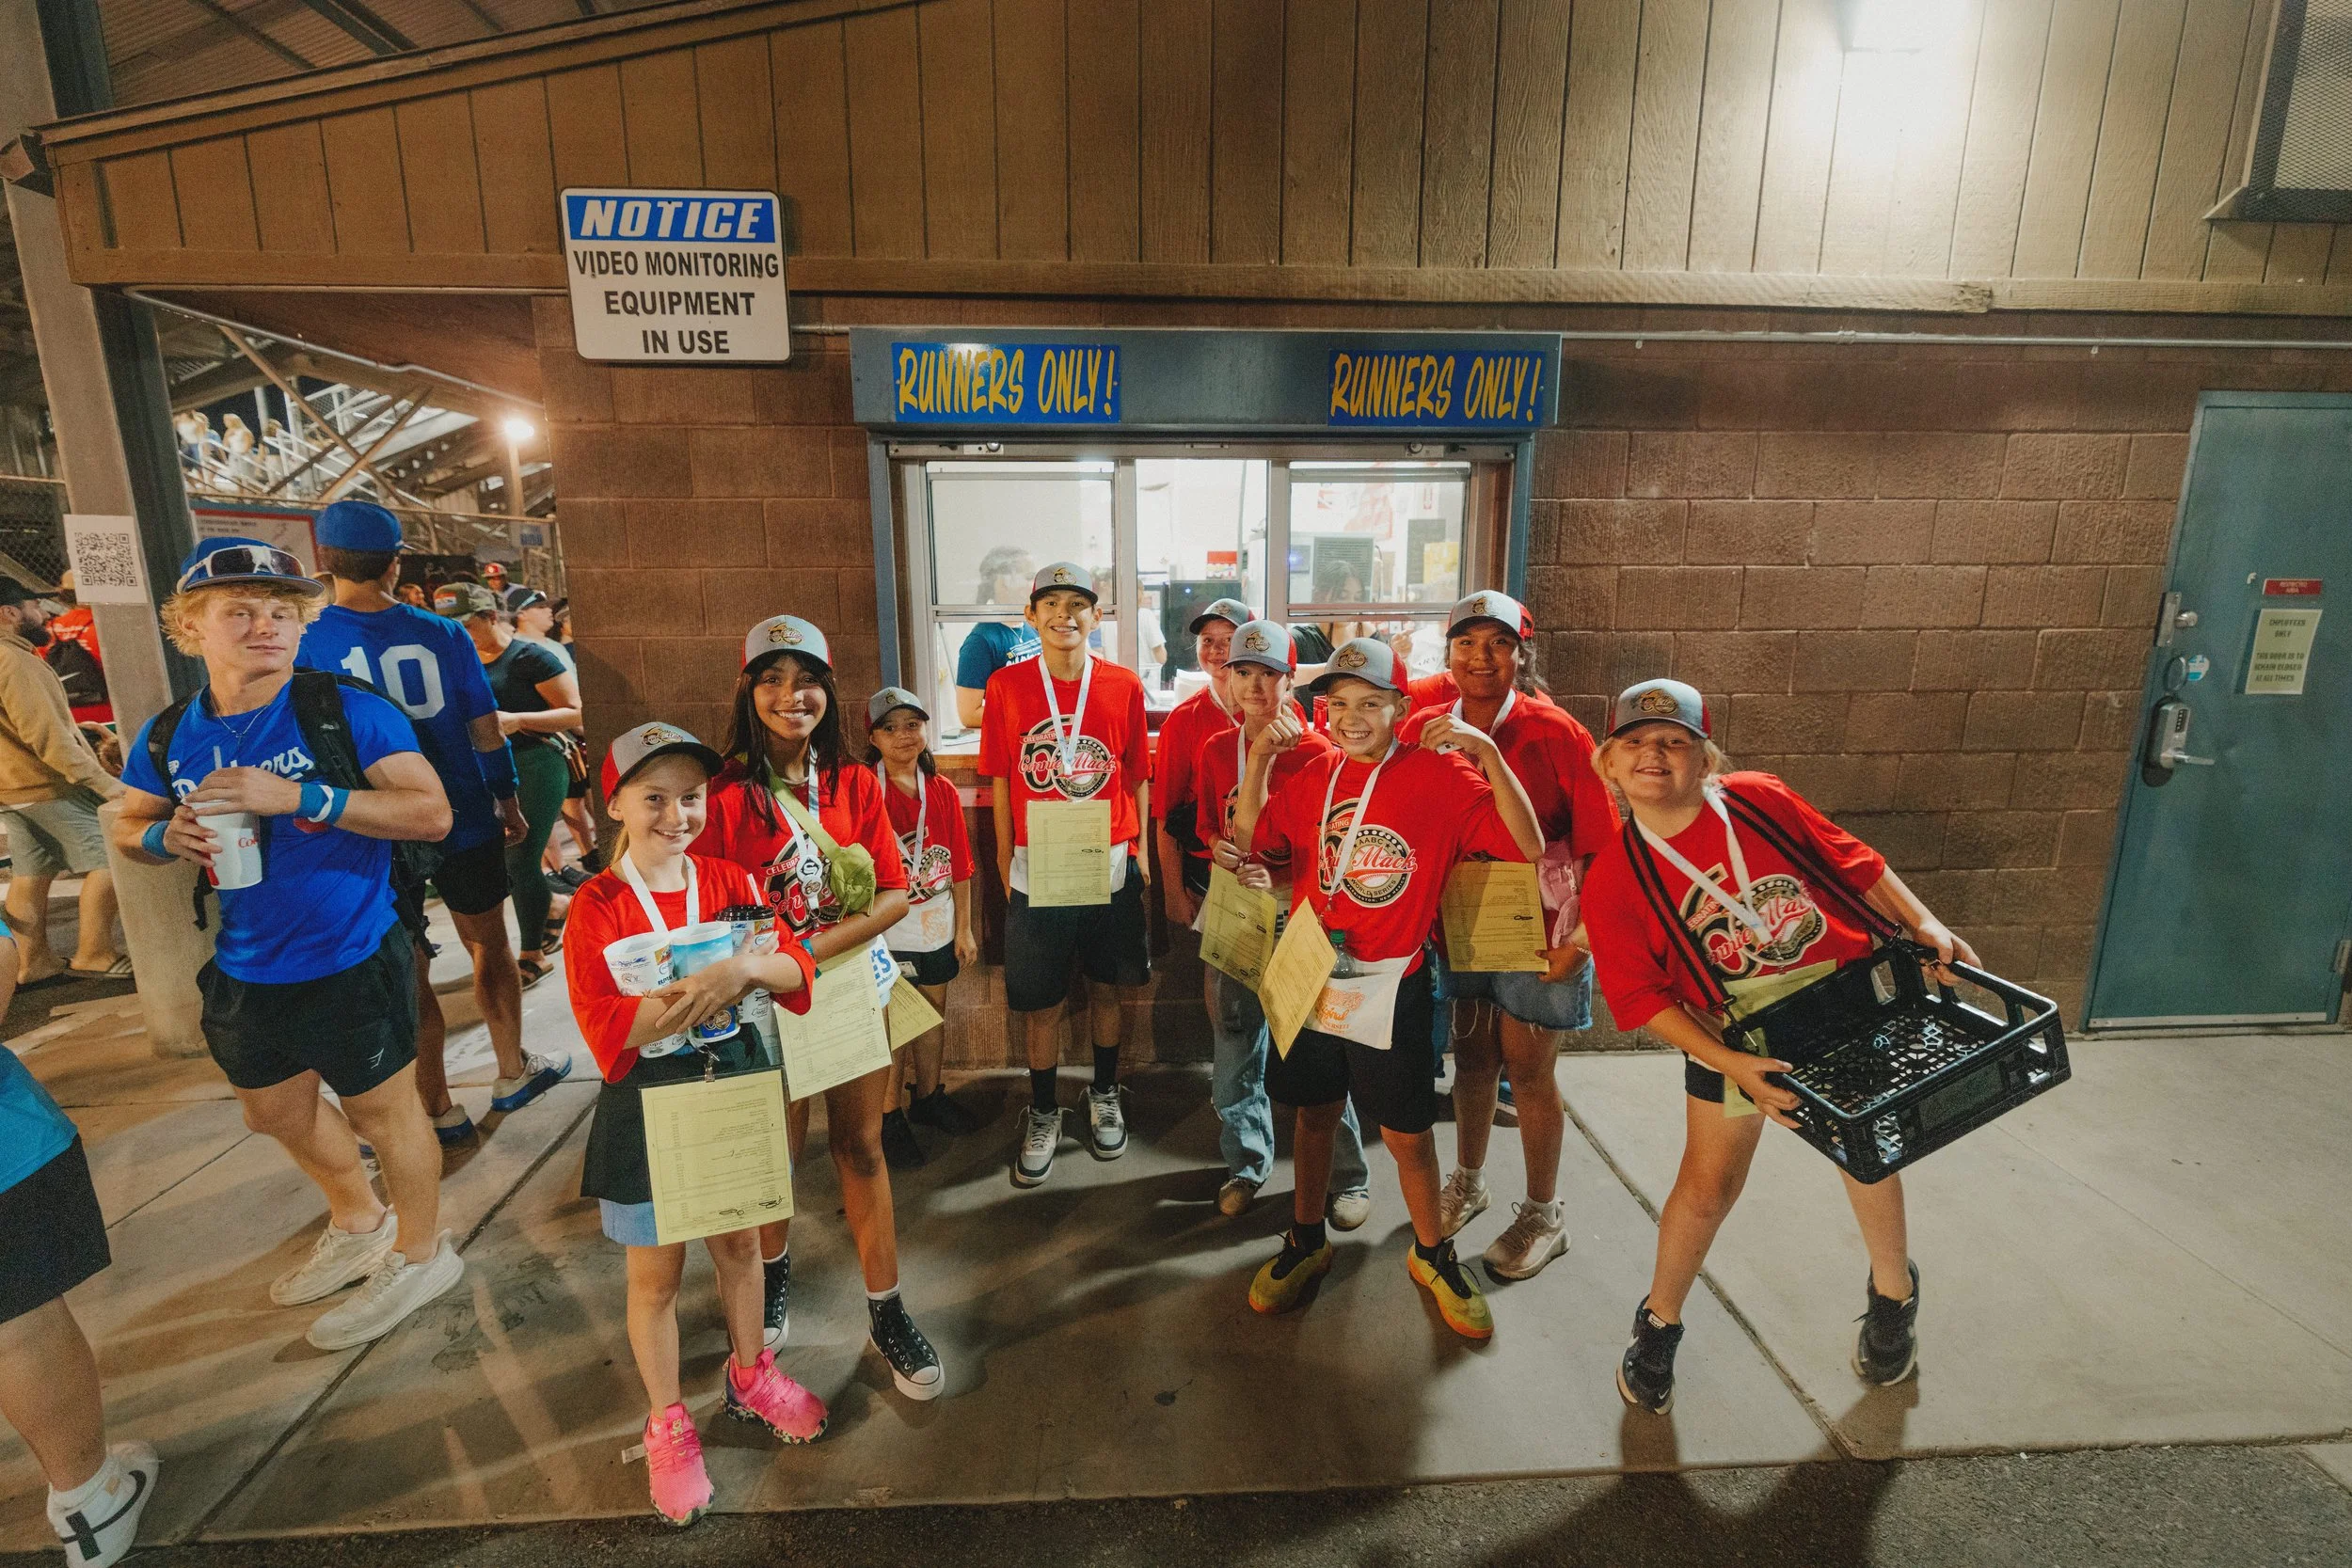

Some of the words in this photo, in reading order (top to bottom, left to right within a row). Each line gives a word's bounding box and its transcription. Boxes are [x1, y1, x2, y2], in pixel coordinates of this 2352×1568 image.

[580, 199, 762, 239] NOTICE
[574, 250, 638, 276] VIDEO
[646, 251, 779, 277] MONITORING
[604, 291, 755, 316] EQUIPMENT
[642, 330, 669, 354] IN
[678, 331, 730, 354] USE
[899, 348, 1024, 414] RUNNERS
[1039, 349, 1115, 416] ONLY!
[1330, 353, 1455, 419] RUNNERS
[1465, 356, 1542, 421] ONLY!
[341, 644, 445, 720] 10
[1071, 752, 1116, 773] Mack
[1359, 837, 1384, 846] AABC
[1352, 845, 1418, 873] Mack
[1351, 879, 1373, 896] WORLD
[1374, 879, 1396, 896] SERIES
